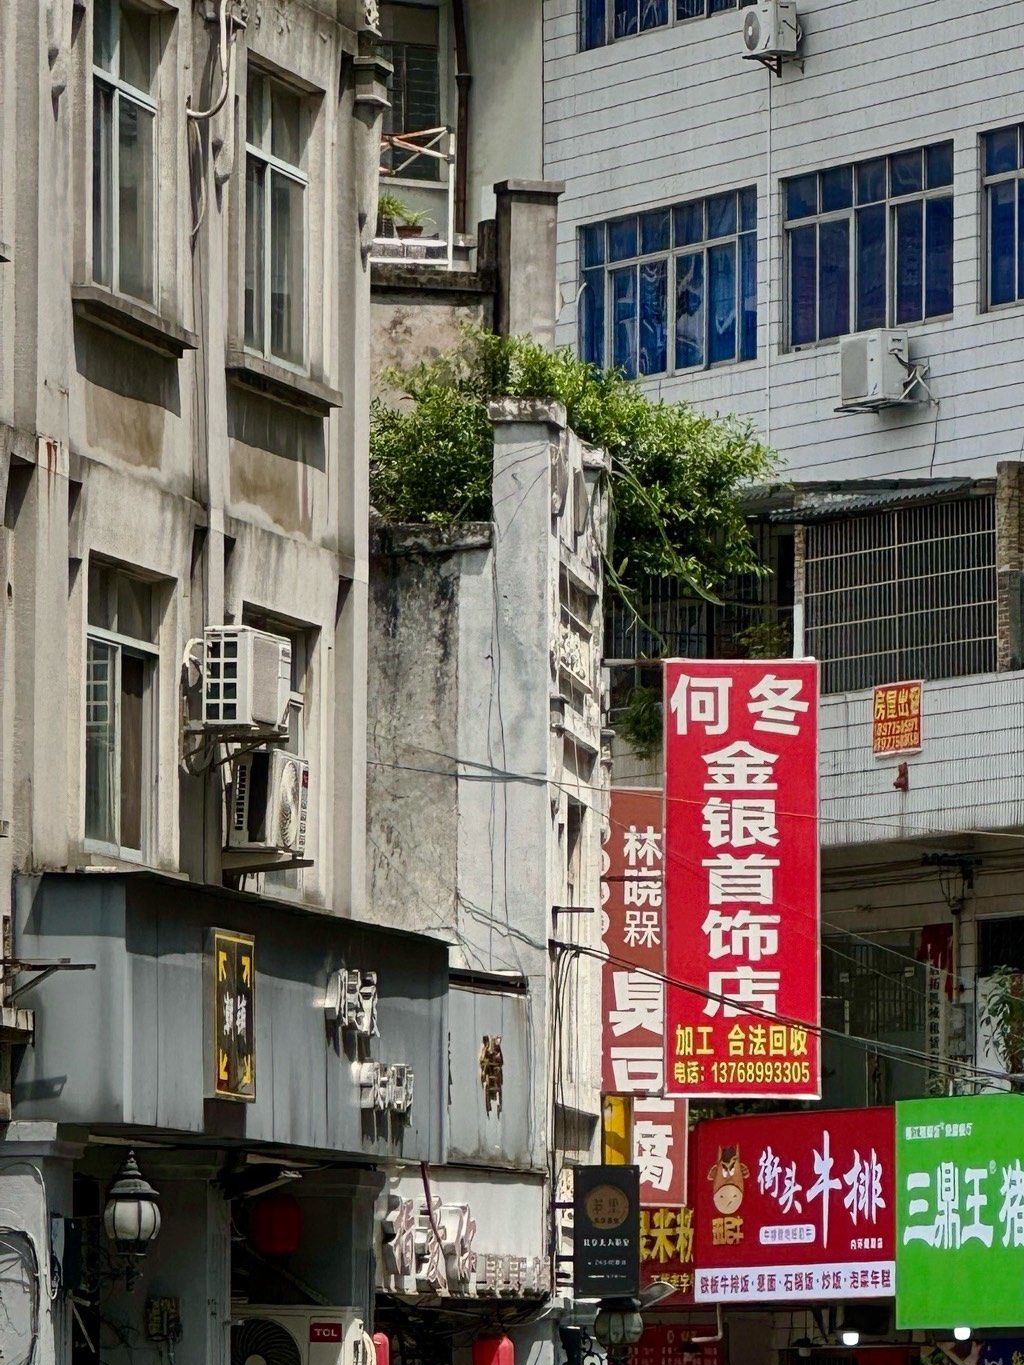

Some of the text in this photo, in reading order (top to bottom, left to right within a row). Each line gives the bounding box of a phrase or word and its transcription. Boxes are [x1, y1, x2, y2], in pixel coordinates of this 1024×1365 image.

[671, 674, 809, 736] 何冬
[701, 740, 781, 1018] 金银首饰店
[675, 1023, 809, 1057] 加工 合法回收
[757, 1130, 887, 1250] 街头牛排
[313, 1328, 338, 1337] TCL
